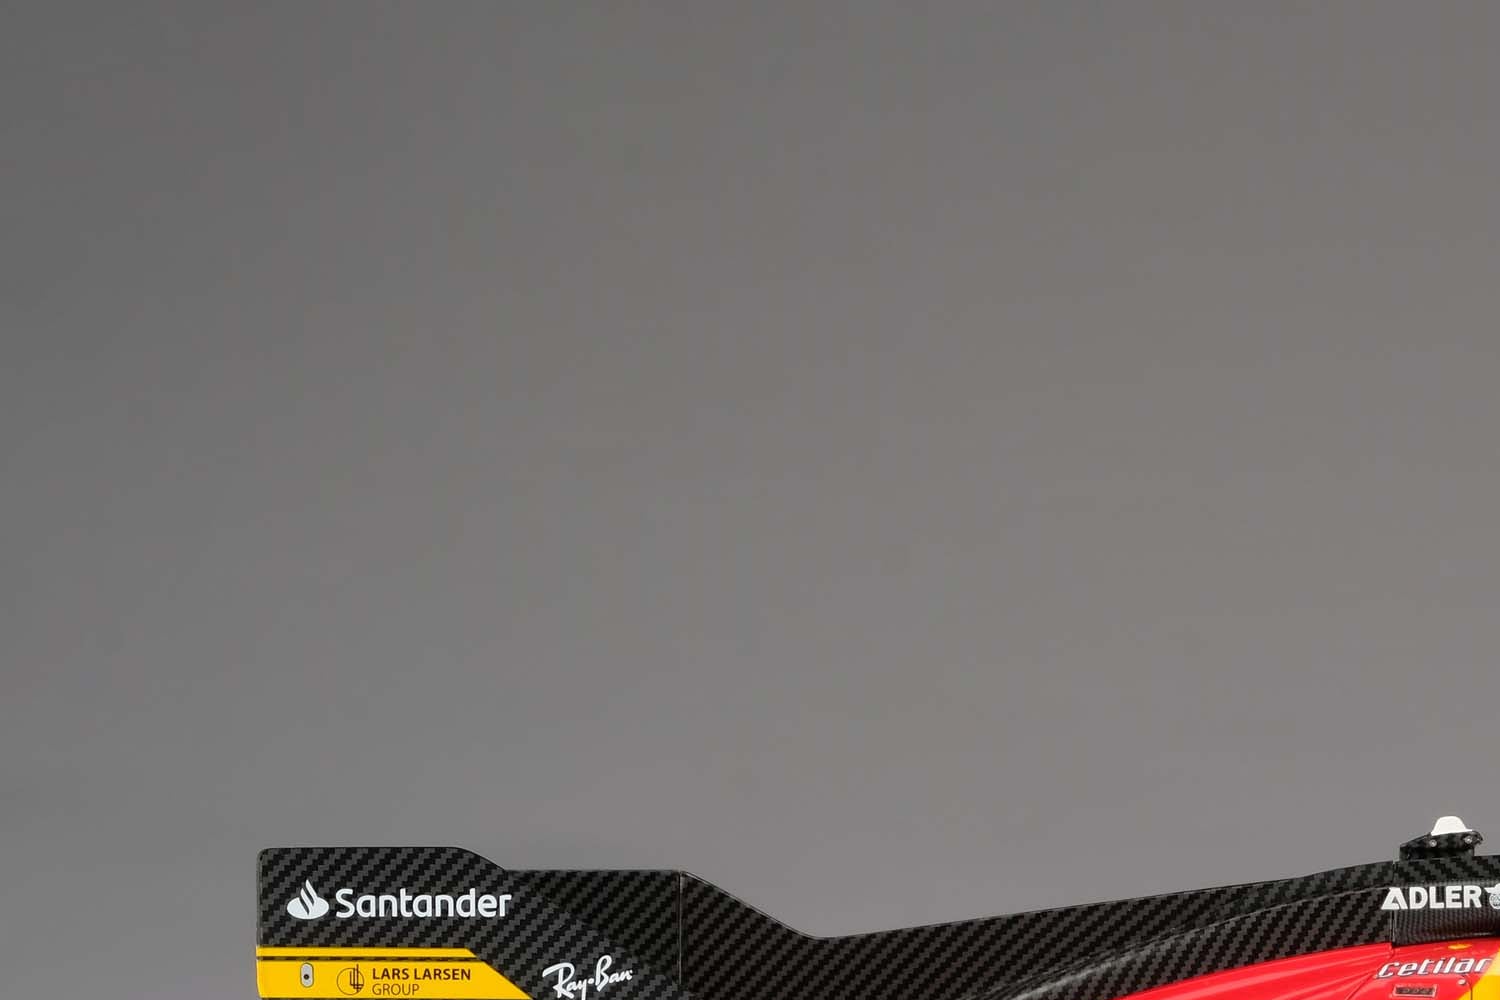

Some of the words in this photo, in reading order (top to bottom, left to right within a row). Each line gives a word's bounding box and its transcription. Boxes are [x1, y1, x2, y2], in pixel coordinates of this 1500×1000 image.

[336, 888, 512, 918] Santander
[1381, 885, 1482, 910] ADLER
[372, 968, 410, 981] LARS
[413, 968, 471, 981] LARSEN
[372, 983, 420, 996] GROUP
